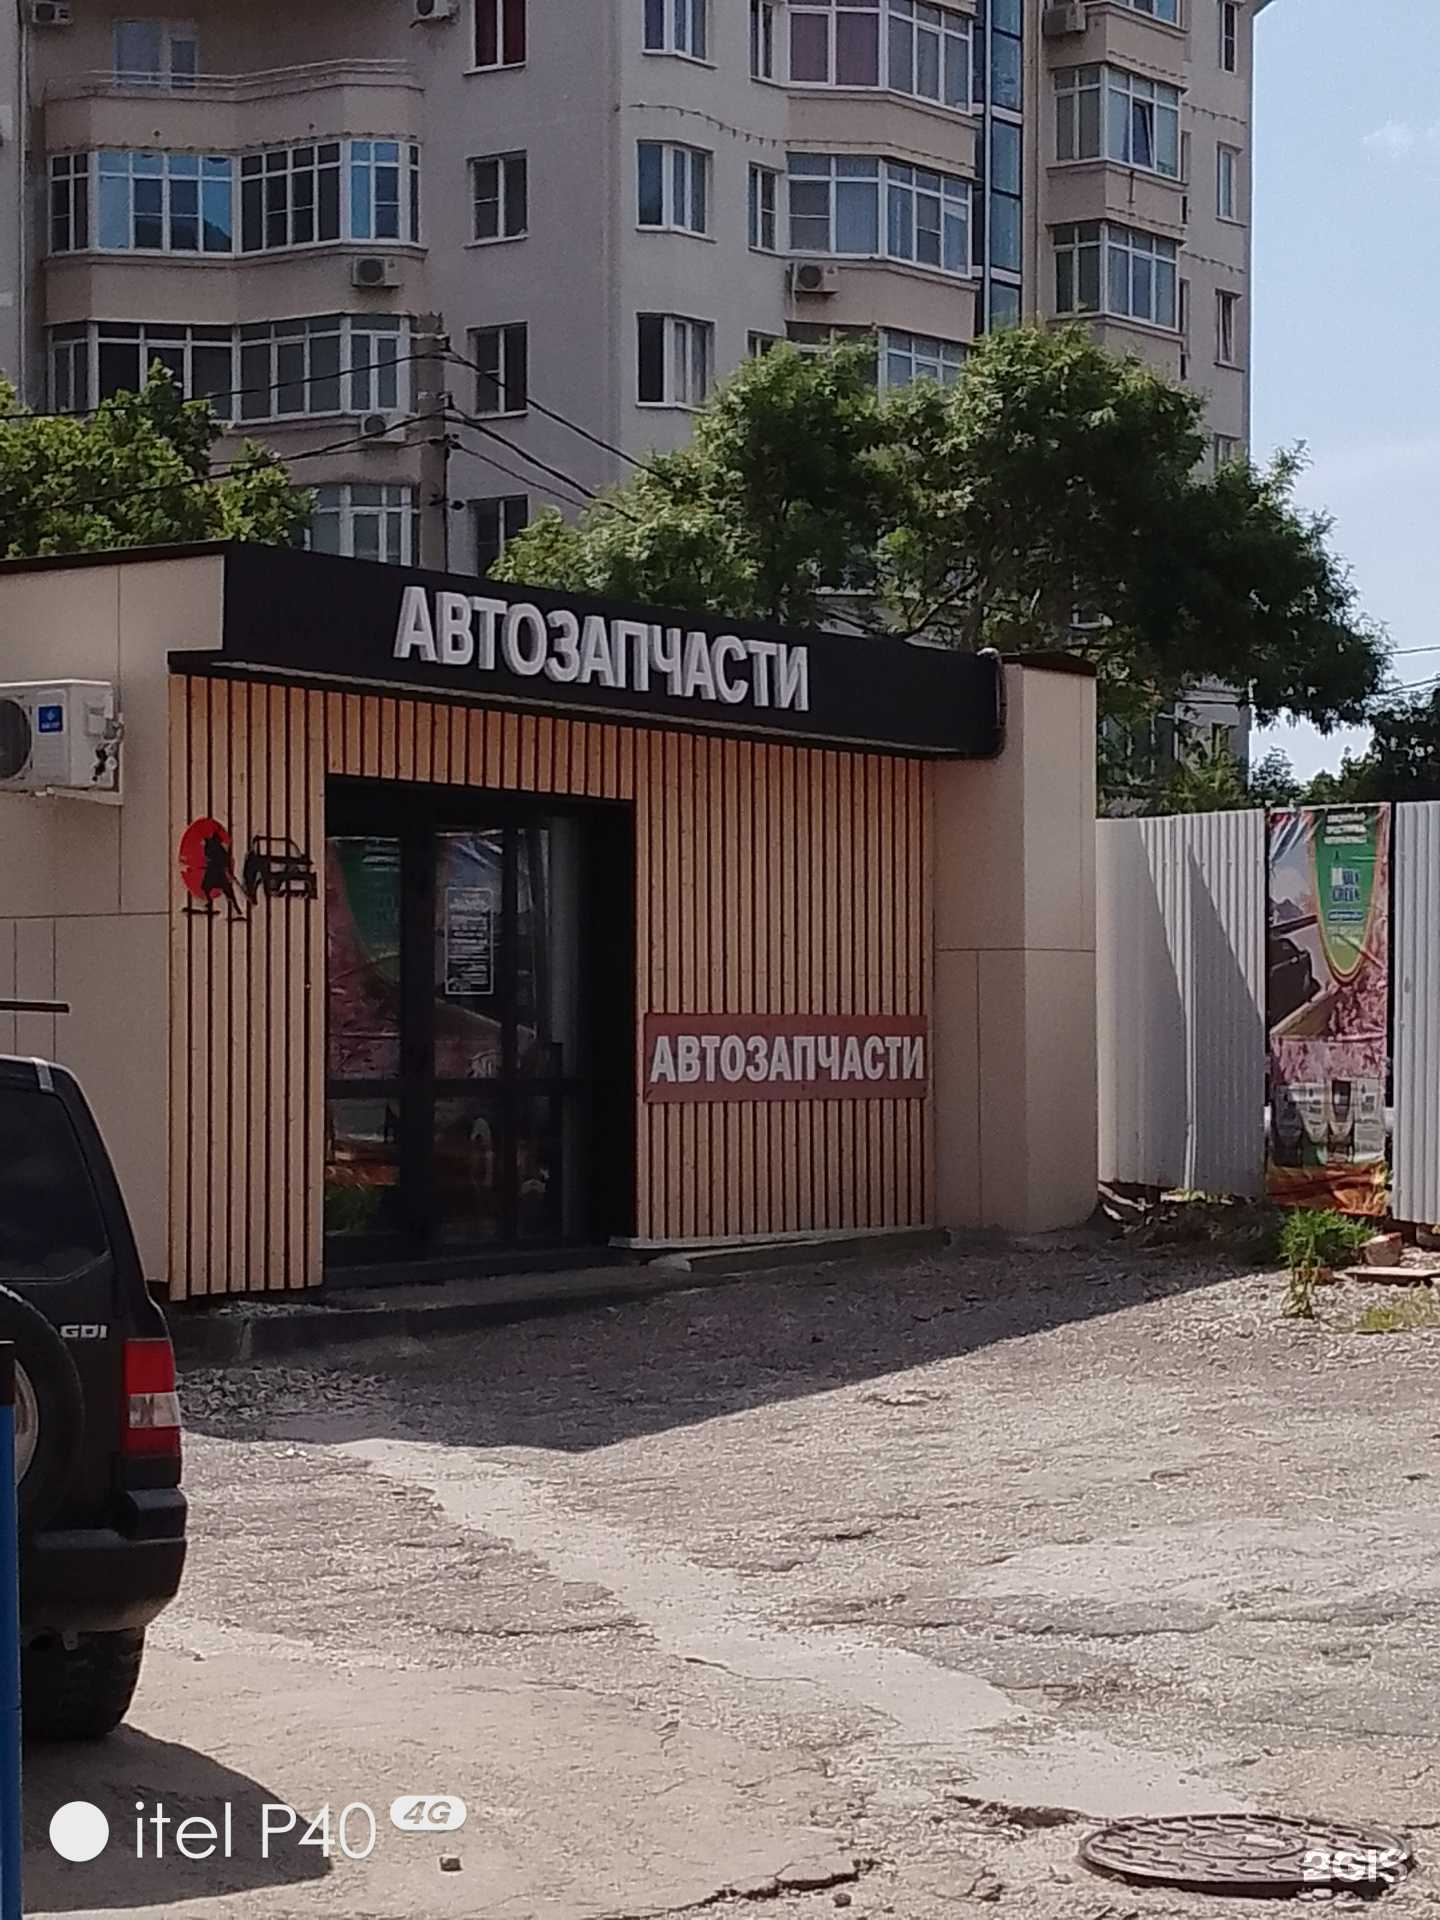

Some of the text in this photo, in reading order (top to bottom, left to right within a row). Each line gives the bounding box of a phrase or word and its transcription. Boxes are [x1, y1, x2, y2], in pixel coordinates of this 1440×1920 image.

[393, 586, 809, 712] АВТОЗАПЧАСТИ
[649, 1034, 924, 1083] АВТОЗАПЧАСТИ
[60, 1325, 108, 1339] GDI
